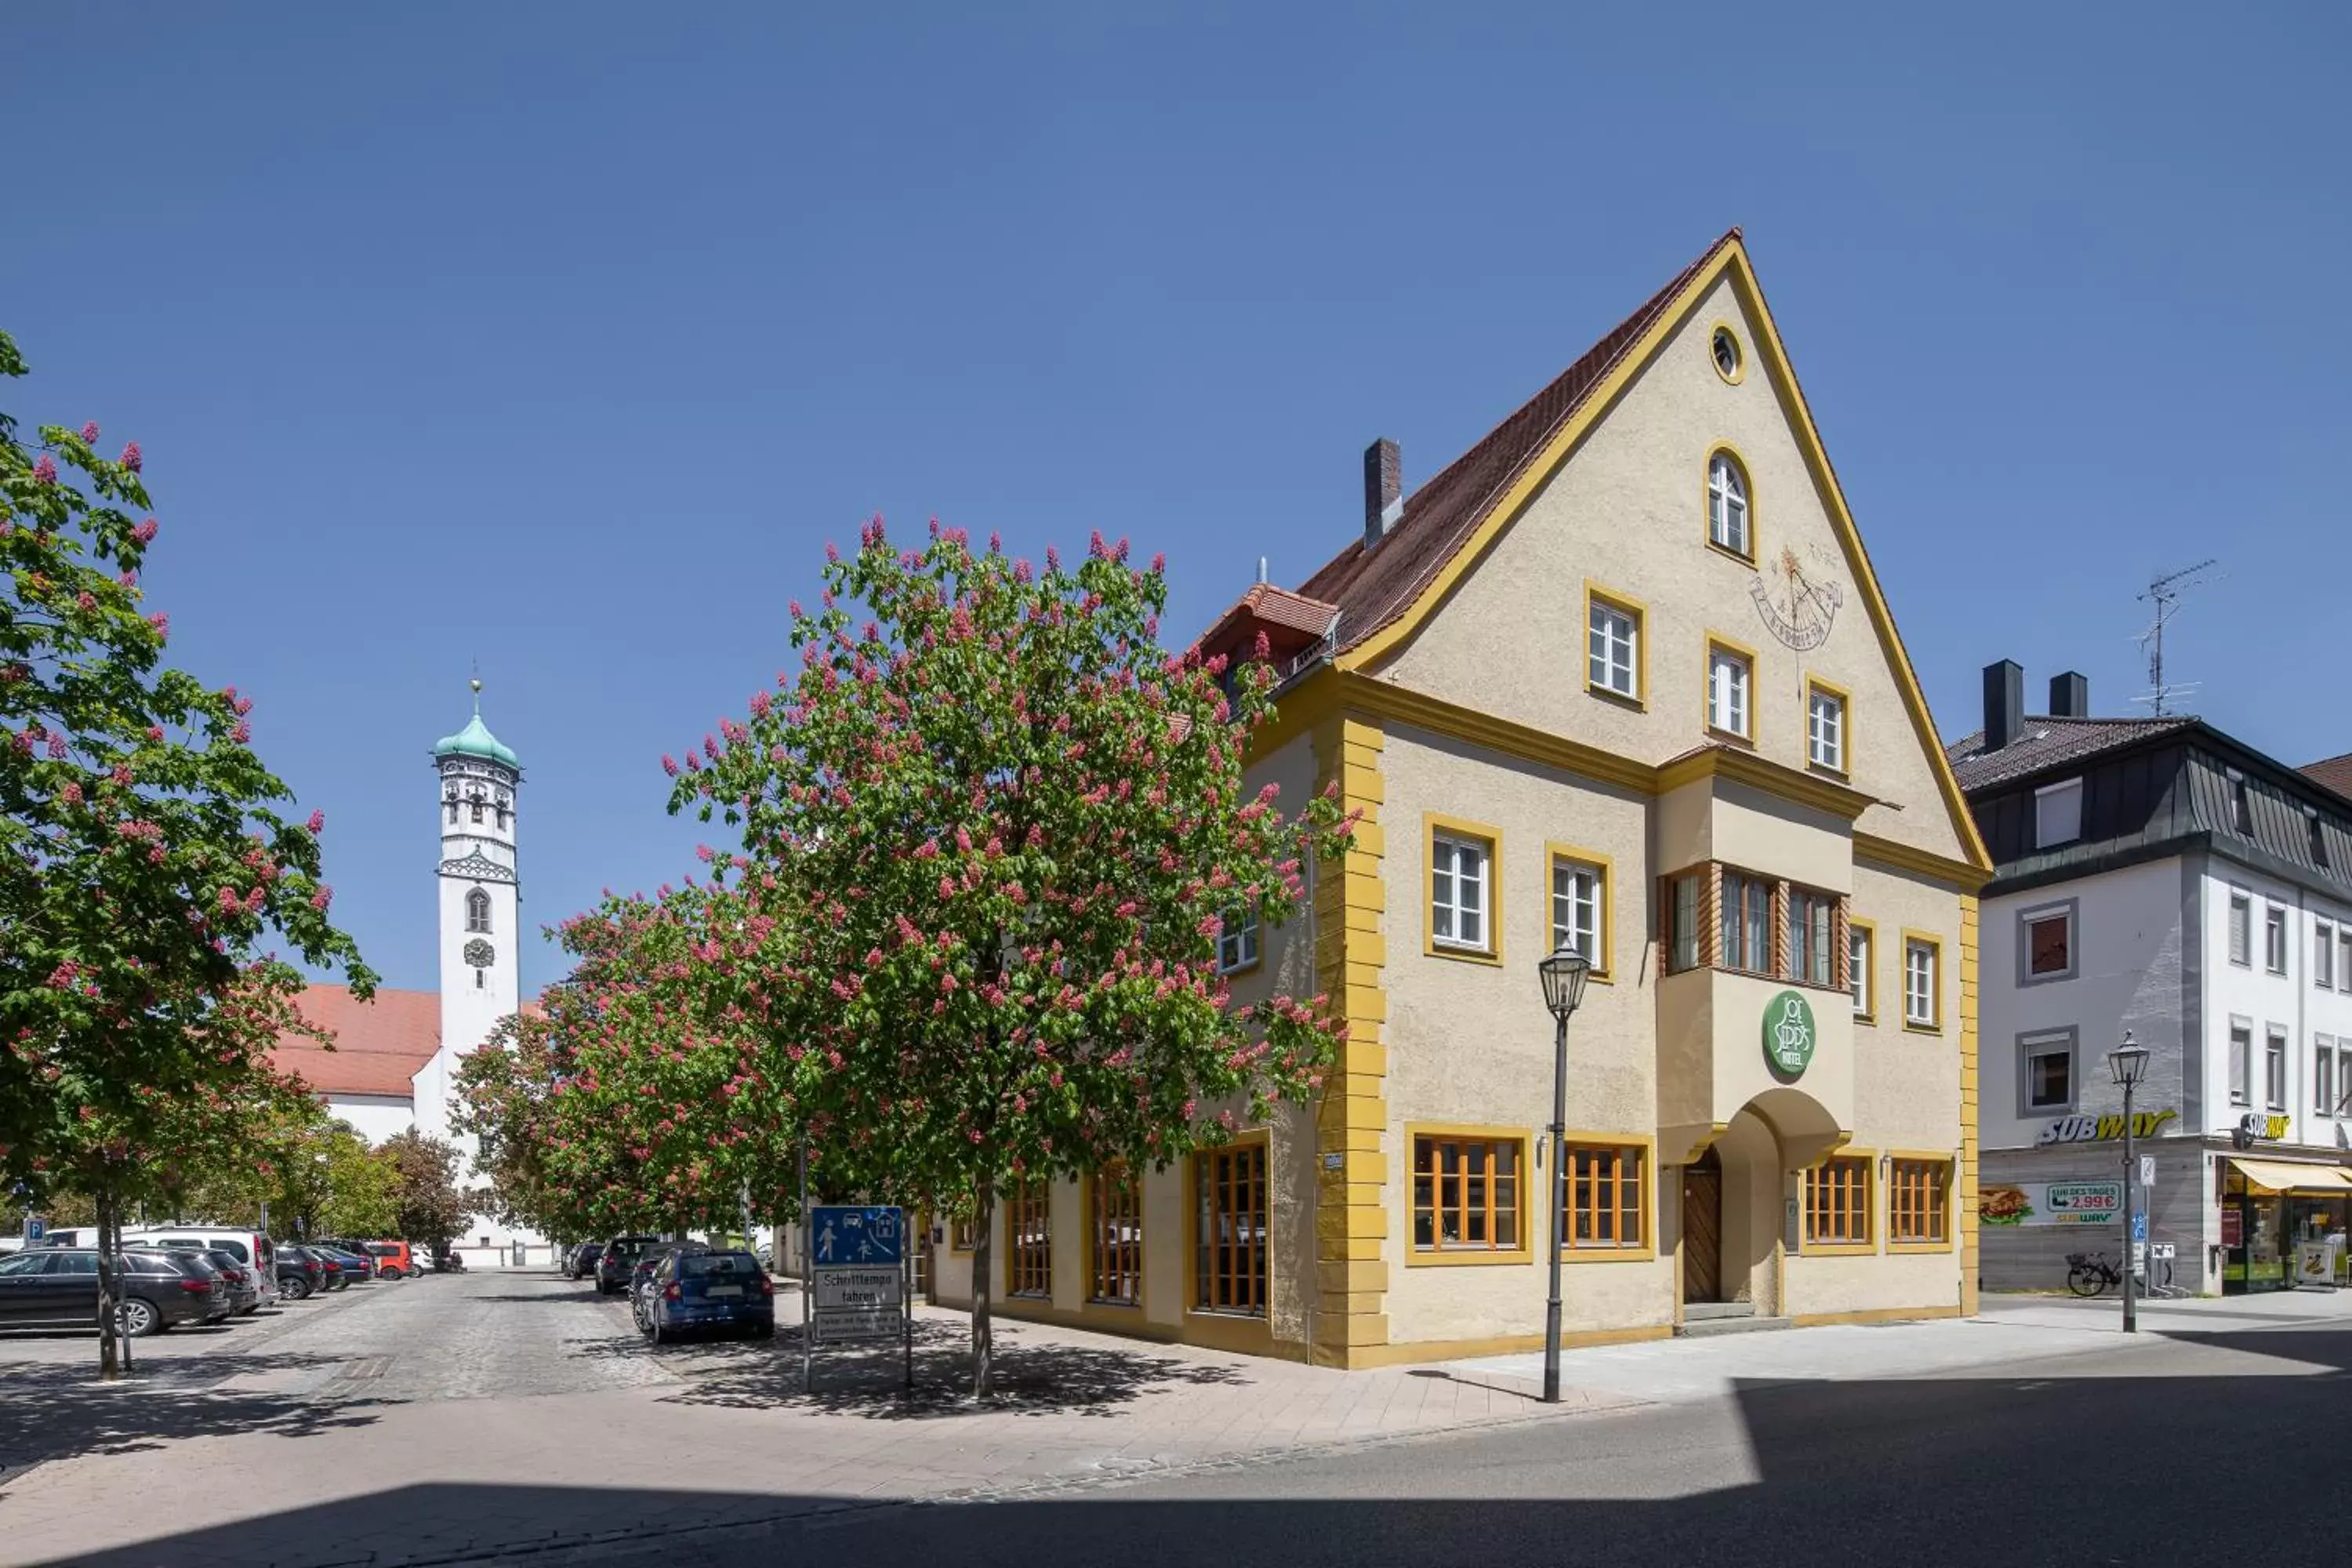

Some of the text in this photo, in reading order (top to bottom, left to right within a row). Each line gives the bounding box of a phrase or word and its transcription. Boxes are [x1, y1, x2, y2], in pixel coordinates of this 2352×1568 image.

[2039, 1110, 2177, 1144] SUBWAY
[2245, 1112, 2291, 1139] SUBWAY
[2057, 1213, 2111, 1222] SUBWAY
[32, 1223, 40, 1237] P
[842, 1290, 876, 1302] fahren
